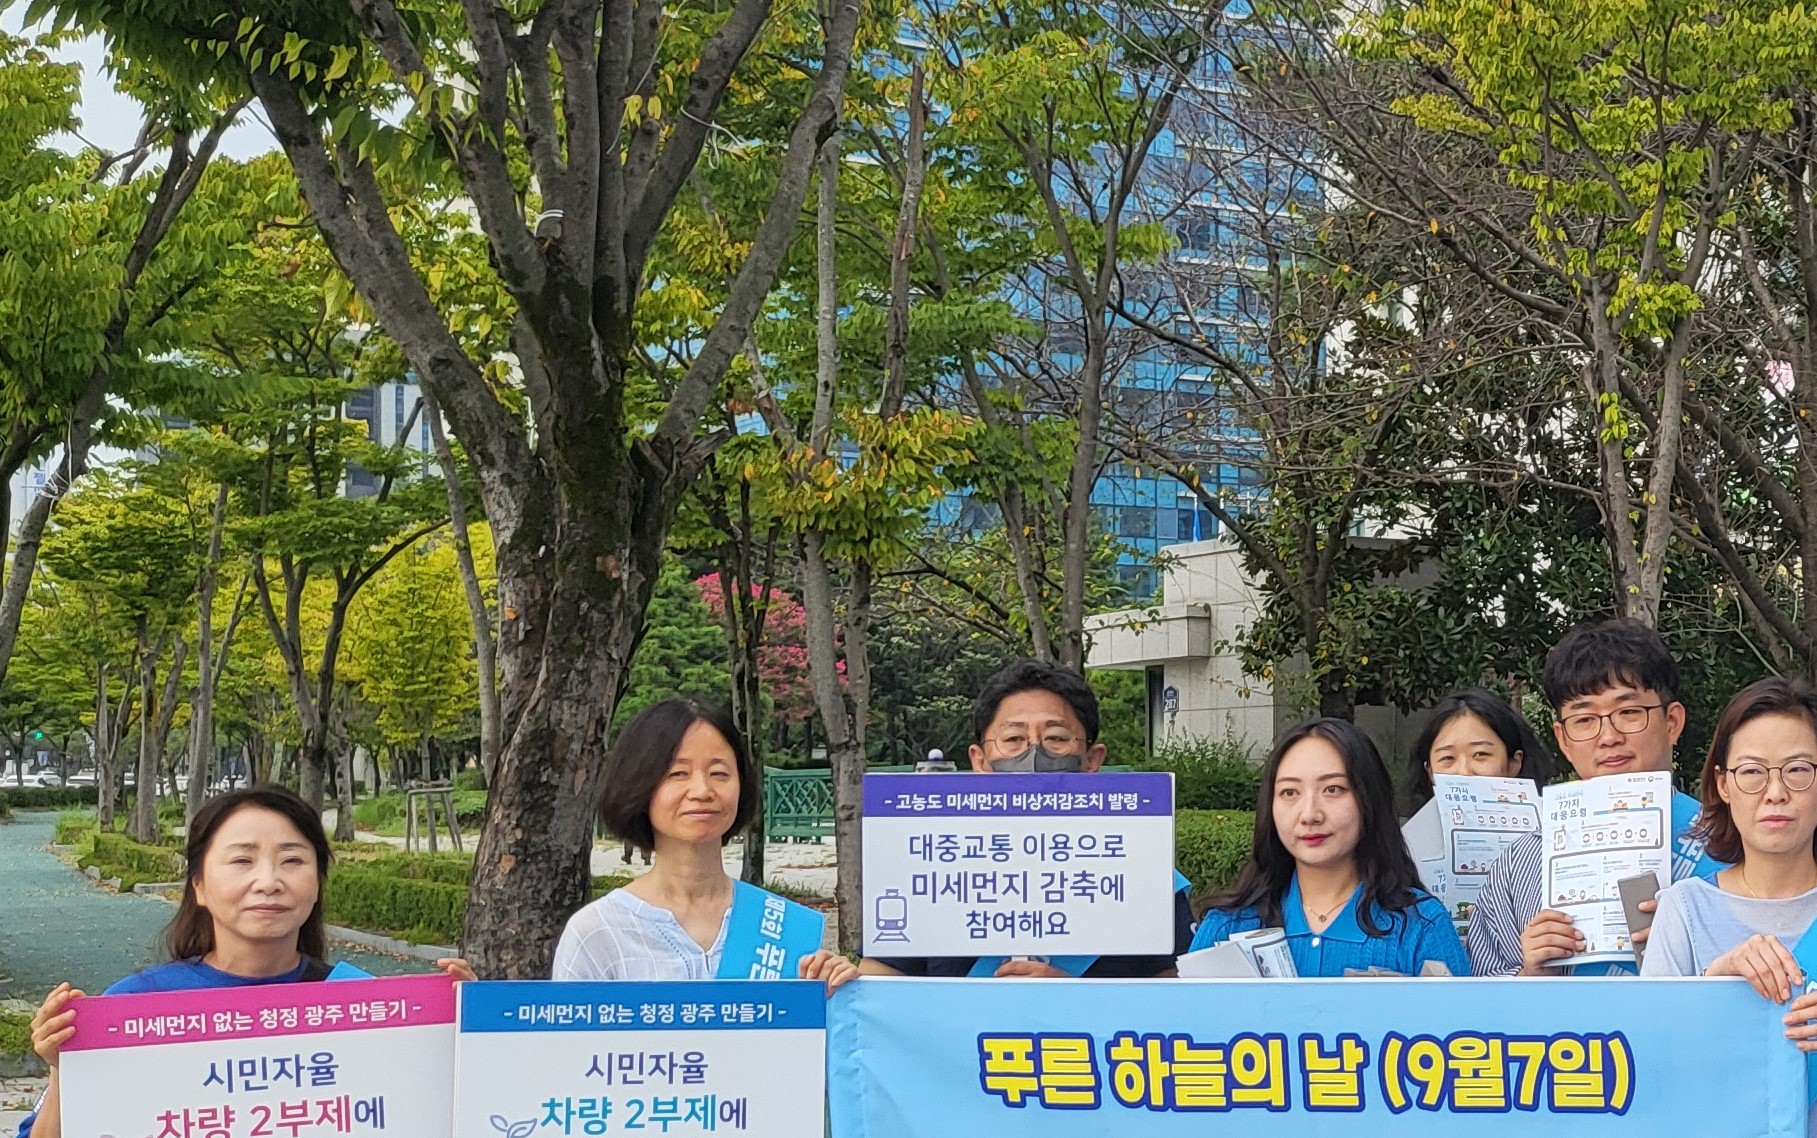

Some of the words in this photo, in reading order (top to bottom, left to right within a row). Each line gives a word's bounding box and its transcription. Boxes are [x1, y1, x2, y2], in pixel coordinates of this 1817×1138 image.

[895, 793, 943, 812] 고농도
[946, 792, 1008, 811] 미세먼지
[1012, 792, 1104, 811] 비상저감조치
[1107, 792, 1138, 811] 발령
[909, 833, 1014, 863] 대중교통
[1023, 832, 1127, 863] 이용으로
[912, 870, 1028, 904] 미세먼지
[1040, 869, 1124, 904] 감축에
[759, 895, 786, 940] 제5회
[965, 909, 1071, 940] 참여해요
[124, 1013, 206, 1039] 미세먼지
[212, 1011, 254, 1033] 없는
[259, 1006, 298, 1030] 청정
[304, 1004, 345, 1026] 광주
[348, 999, 407, 1023] 만들기
[518, 1003, 592, 1025] 미세먼지
[597, 1003, 635, 1024] 없는
[639, 1003, 675, 1024] 청정
[679, 1003, 717, 1024] 광주
[720, 1002, 773, 1023] 만들기
[202, 1051, 340, 1094] 시민자율
[584, 1051, 709, 1086] 시민자율
[982, 1037, 1096, 1106] 푸른
[1110, 1036, 1286, 1107] 하늘의
[1303, 1038, 1365, 1107] 날
[1383, 1036, 1630, 1110] (9월7일)
[249, 1094, 385, 1138] 2부제에
[540, 1096, 613, 1136] 차량
[624, 1094, 747, 1133] 2부제에
